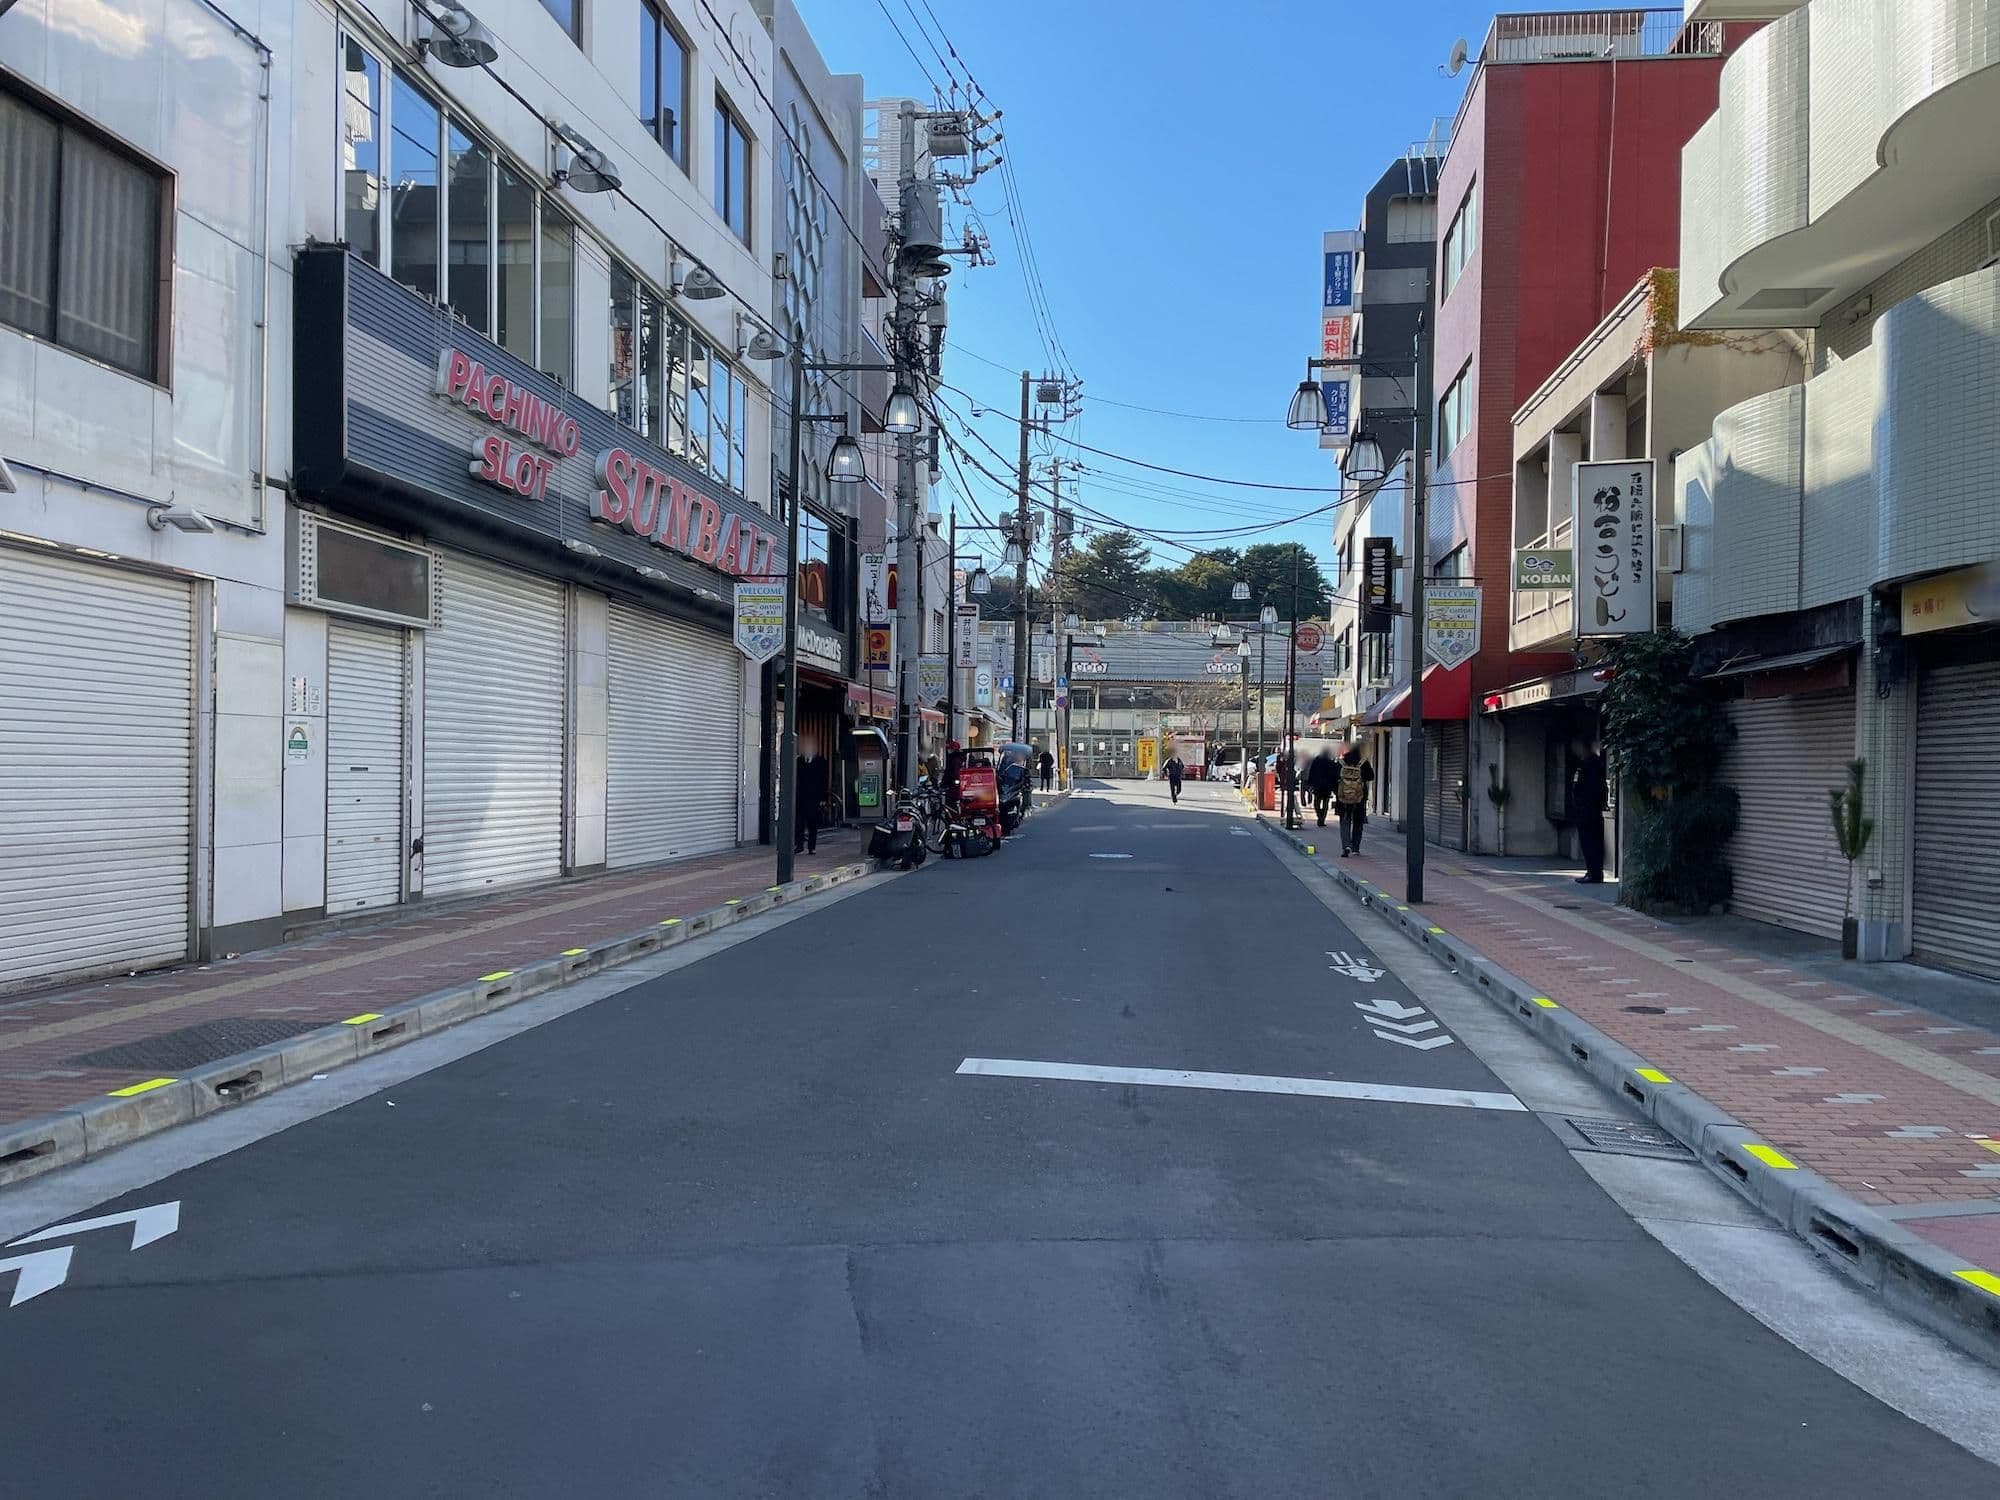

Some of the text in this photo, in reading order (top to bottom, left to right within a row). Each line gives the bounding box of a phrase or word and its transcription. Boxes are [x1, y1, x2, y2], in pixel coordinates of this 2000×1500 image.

[1324, 320, 1341, 353] 歯科
[446, 347, 582, 458] PACHINKO
[1330, 389, 1338, 425] クリニック
[479, 435, 554, 502] SLOT
[738, 586, 784, 595] WELCOME
[1429, 589, 1477, 598] WELCOME
[1520, 574, 1571, 584] KOBAN
[798, 625, 842, 661] McDonald's
